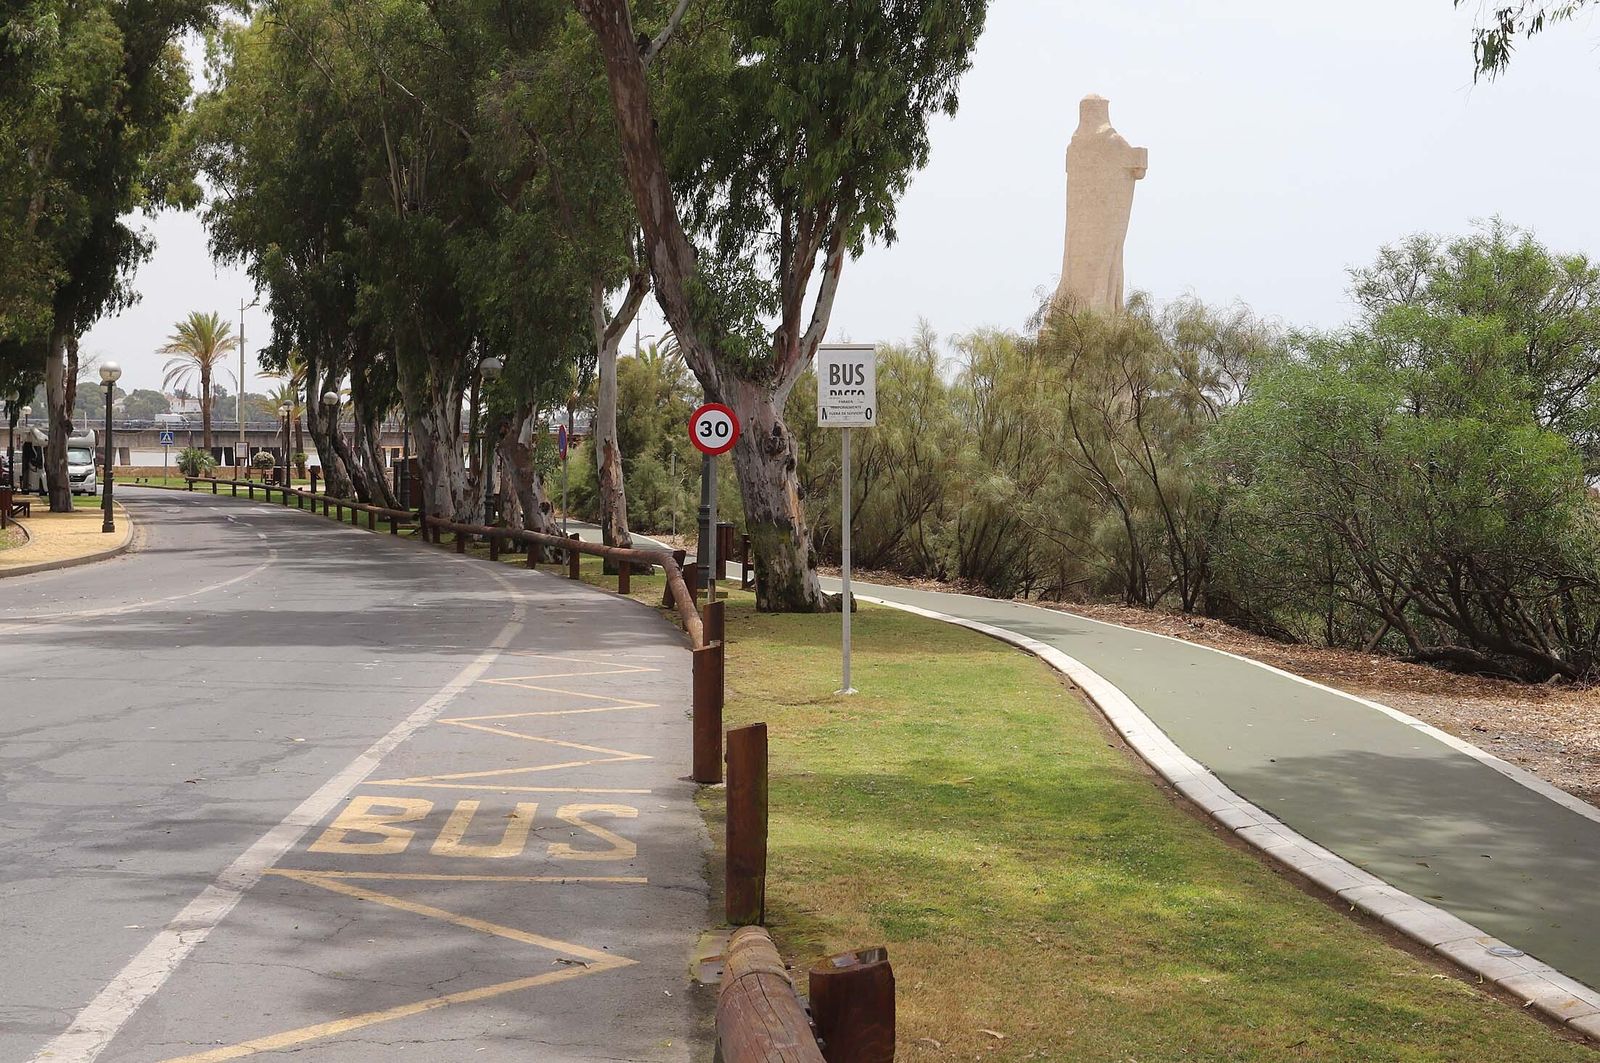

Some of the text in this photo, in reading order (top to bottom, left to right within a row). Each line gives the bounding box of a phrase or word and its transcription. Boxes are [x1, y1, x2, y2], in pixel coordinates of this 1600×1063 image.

[829, 363, 865, 385] BUS
[700, 420, 729, 438] 30
[306, 795, 639, 861] BUS
